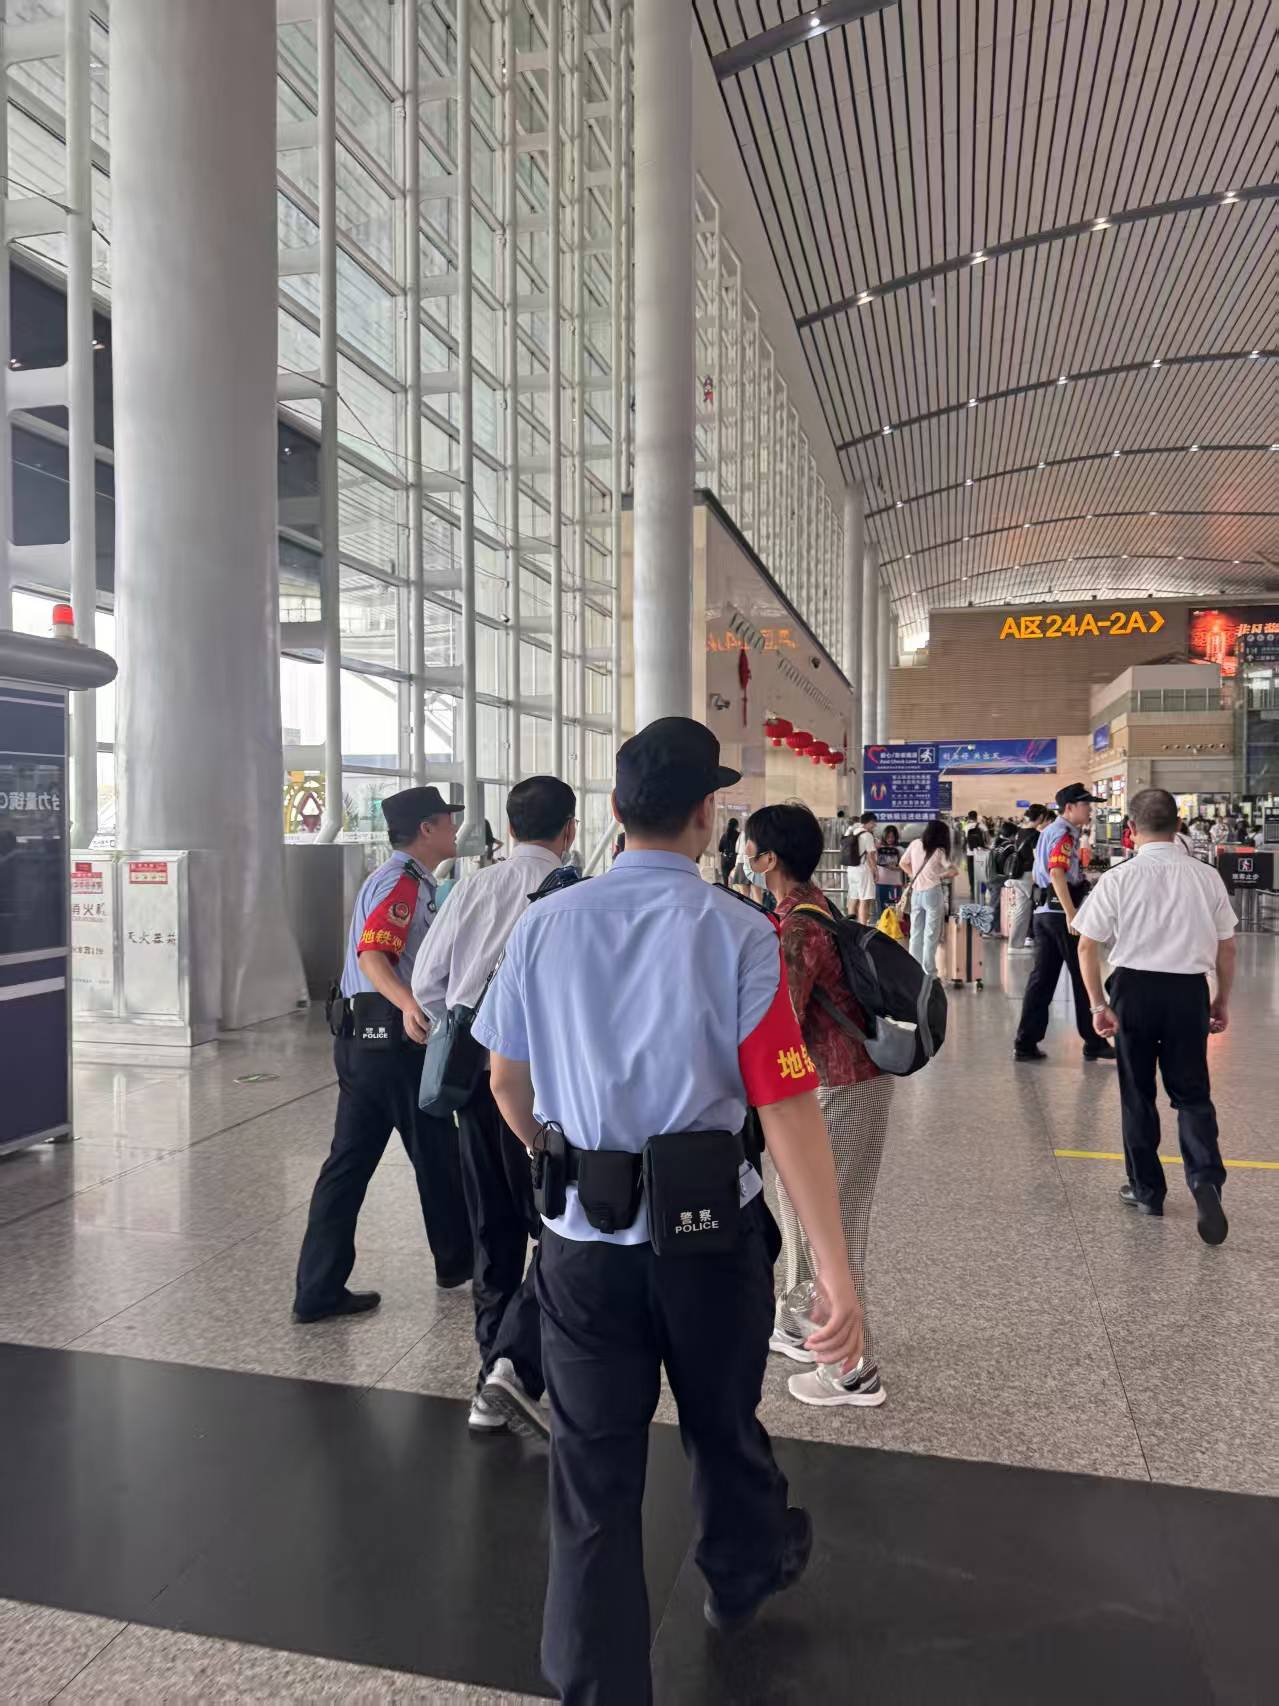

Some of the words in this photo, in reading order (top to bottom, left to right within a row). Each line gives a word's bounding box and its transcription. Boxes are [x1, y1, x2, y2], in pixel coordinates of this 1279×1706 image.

[1000, 611, 1148, 640] A区24A-2A
[680, 1209, 711, 1225] 警察
[675, 1220, 719, 1234] POLICE
